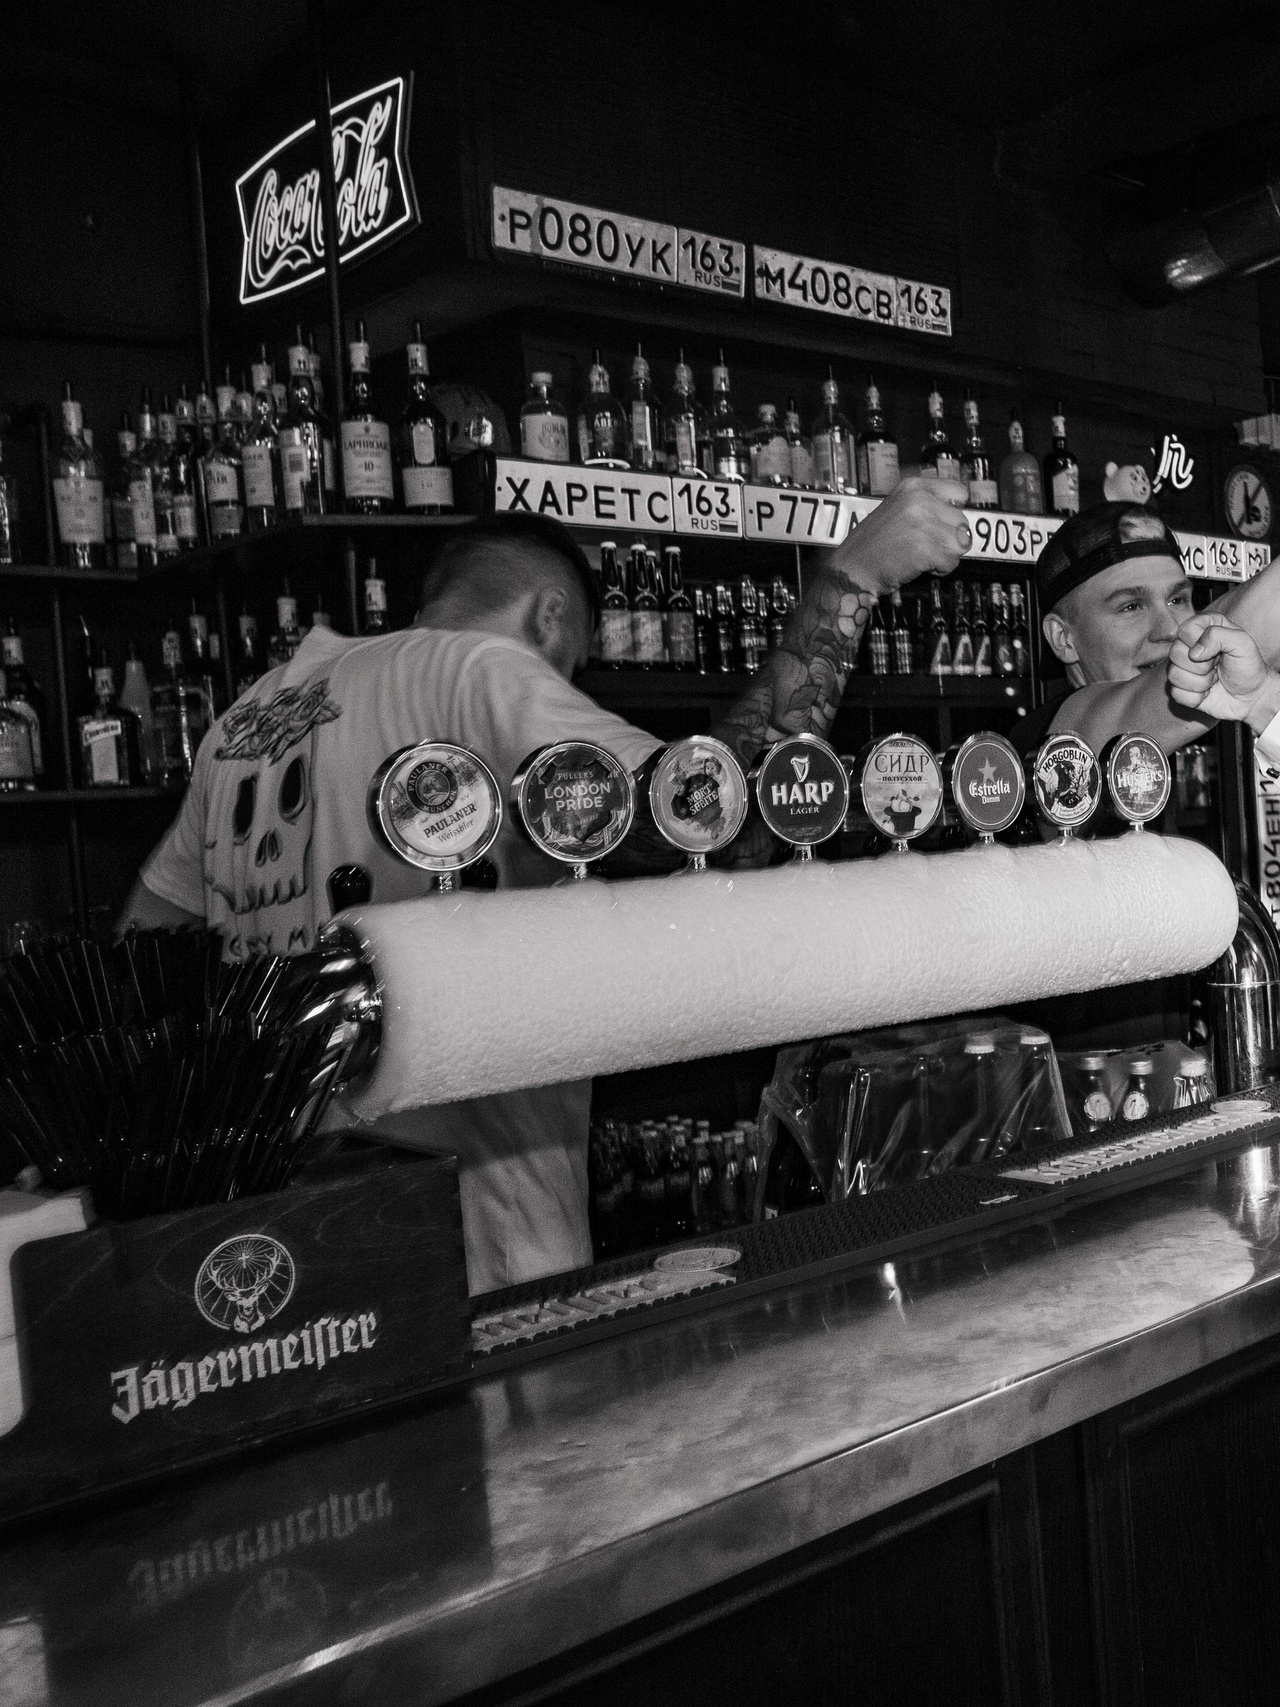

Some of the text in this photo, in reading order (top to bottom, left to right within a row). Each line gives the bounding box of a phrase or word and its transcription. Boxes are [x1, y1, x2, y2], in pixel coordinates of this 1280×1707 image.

[682, 235, 734, 278] 163
[694, 271, 721, 287] RUS
[900, 284, 943, 318] 163
[909, 316, 932, 329] RUS
[506, 476, 731, 523] ХАРЕТС 163
[691, 518, 718, 531] RUS
[969, 517, 1056, 557] 903Р
[1208, 540, 1238, 567] 163
[1215, 565, 1232, 576] RUS
[875, 754, 930, 775] СИДР
[1042, 749, 1088, 773] HOBGOBLIN
[408, 762, 448, 792] PAULANER
[969, 779, 1011, 797] Estrella
[544, 782, 611, 799] LONDON
[686, 783, 711, 805] MORT
[771, 781, 834, 806] HARP
[555, 796, 603, 812] PRIDE
[790, 807, 820, 815] LAGER
[423, 803, 477, 838] PAULANER
